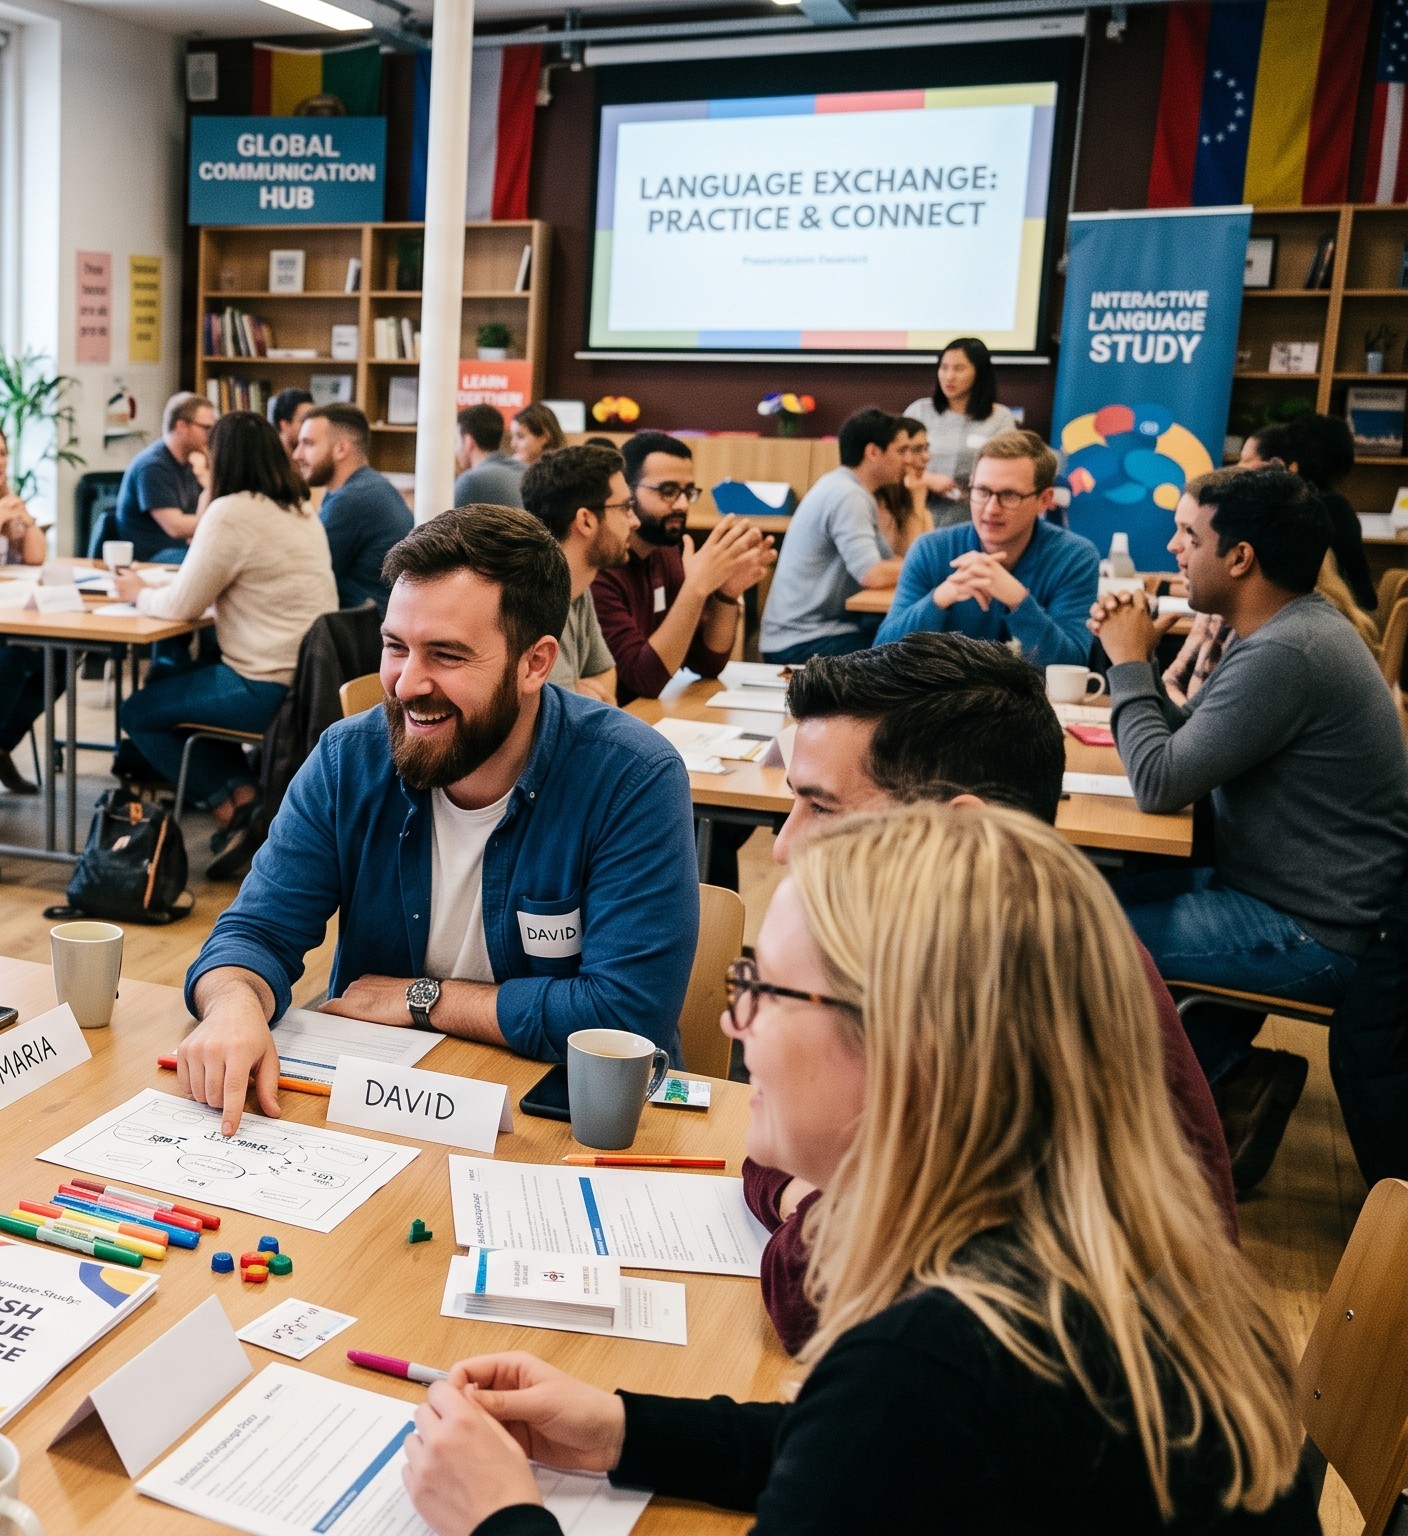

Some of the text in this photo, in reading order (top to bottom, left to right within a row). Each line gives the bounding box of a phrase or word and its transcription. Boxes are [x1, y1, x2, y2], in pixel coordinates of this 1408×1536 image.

[237, 133, 340, 158] GLOBAL
[198, 161, 376, 182] COMMUNICATION
[640, 166, 997, 200] LANGUAGE EXCHANGE:
[259, 185, 315, 210] HUB
[648, 201, 986, 232] PRACTICE & CONNECT
[1091, 290, 1209, 309] INTERACTIVE
[1088, 310, 1206, 332] LANGUAGE
[1089, 333, 1202, 364] STUDY
[526, 926, 577, 941] DAVID
[365, 1079, 455, 1120] DAVID
